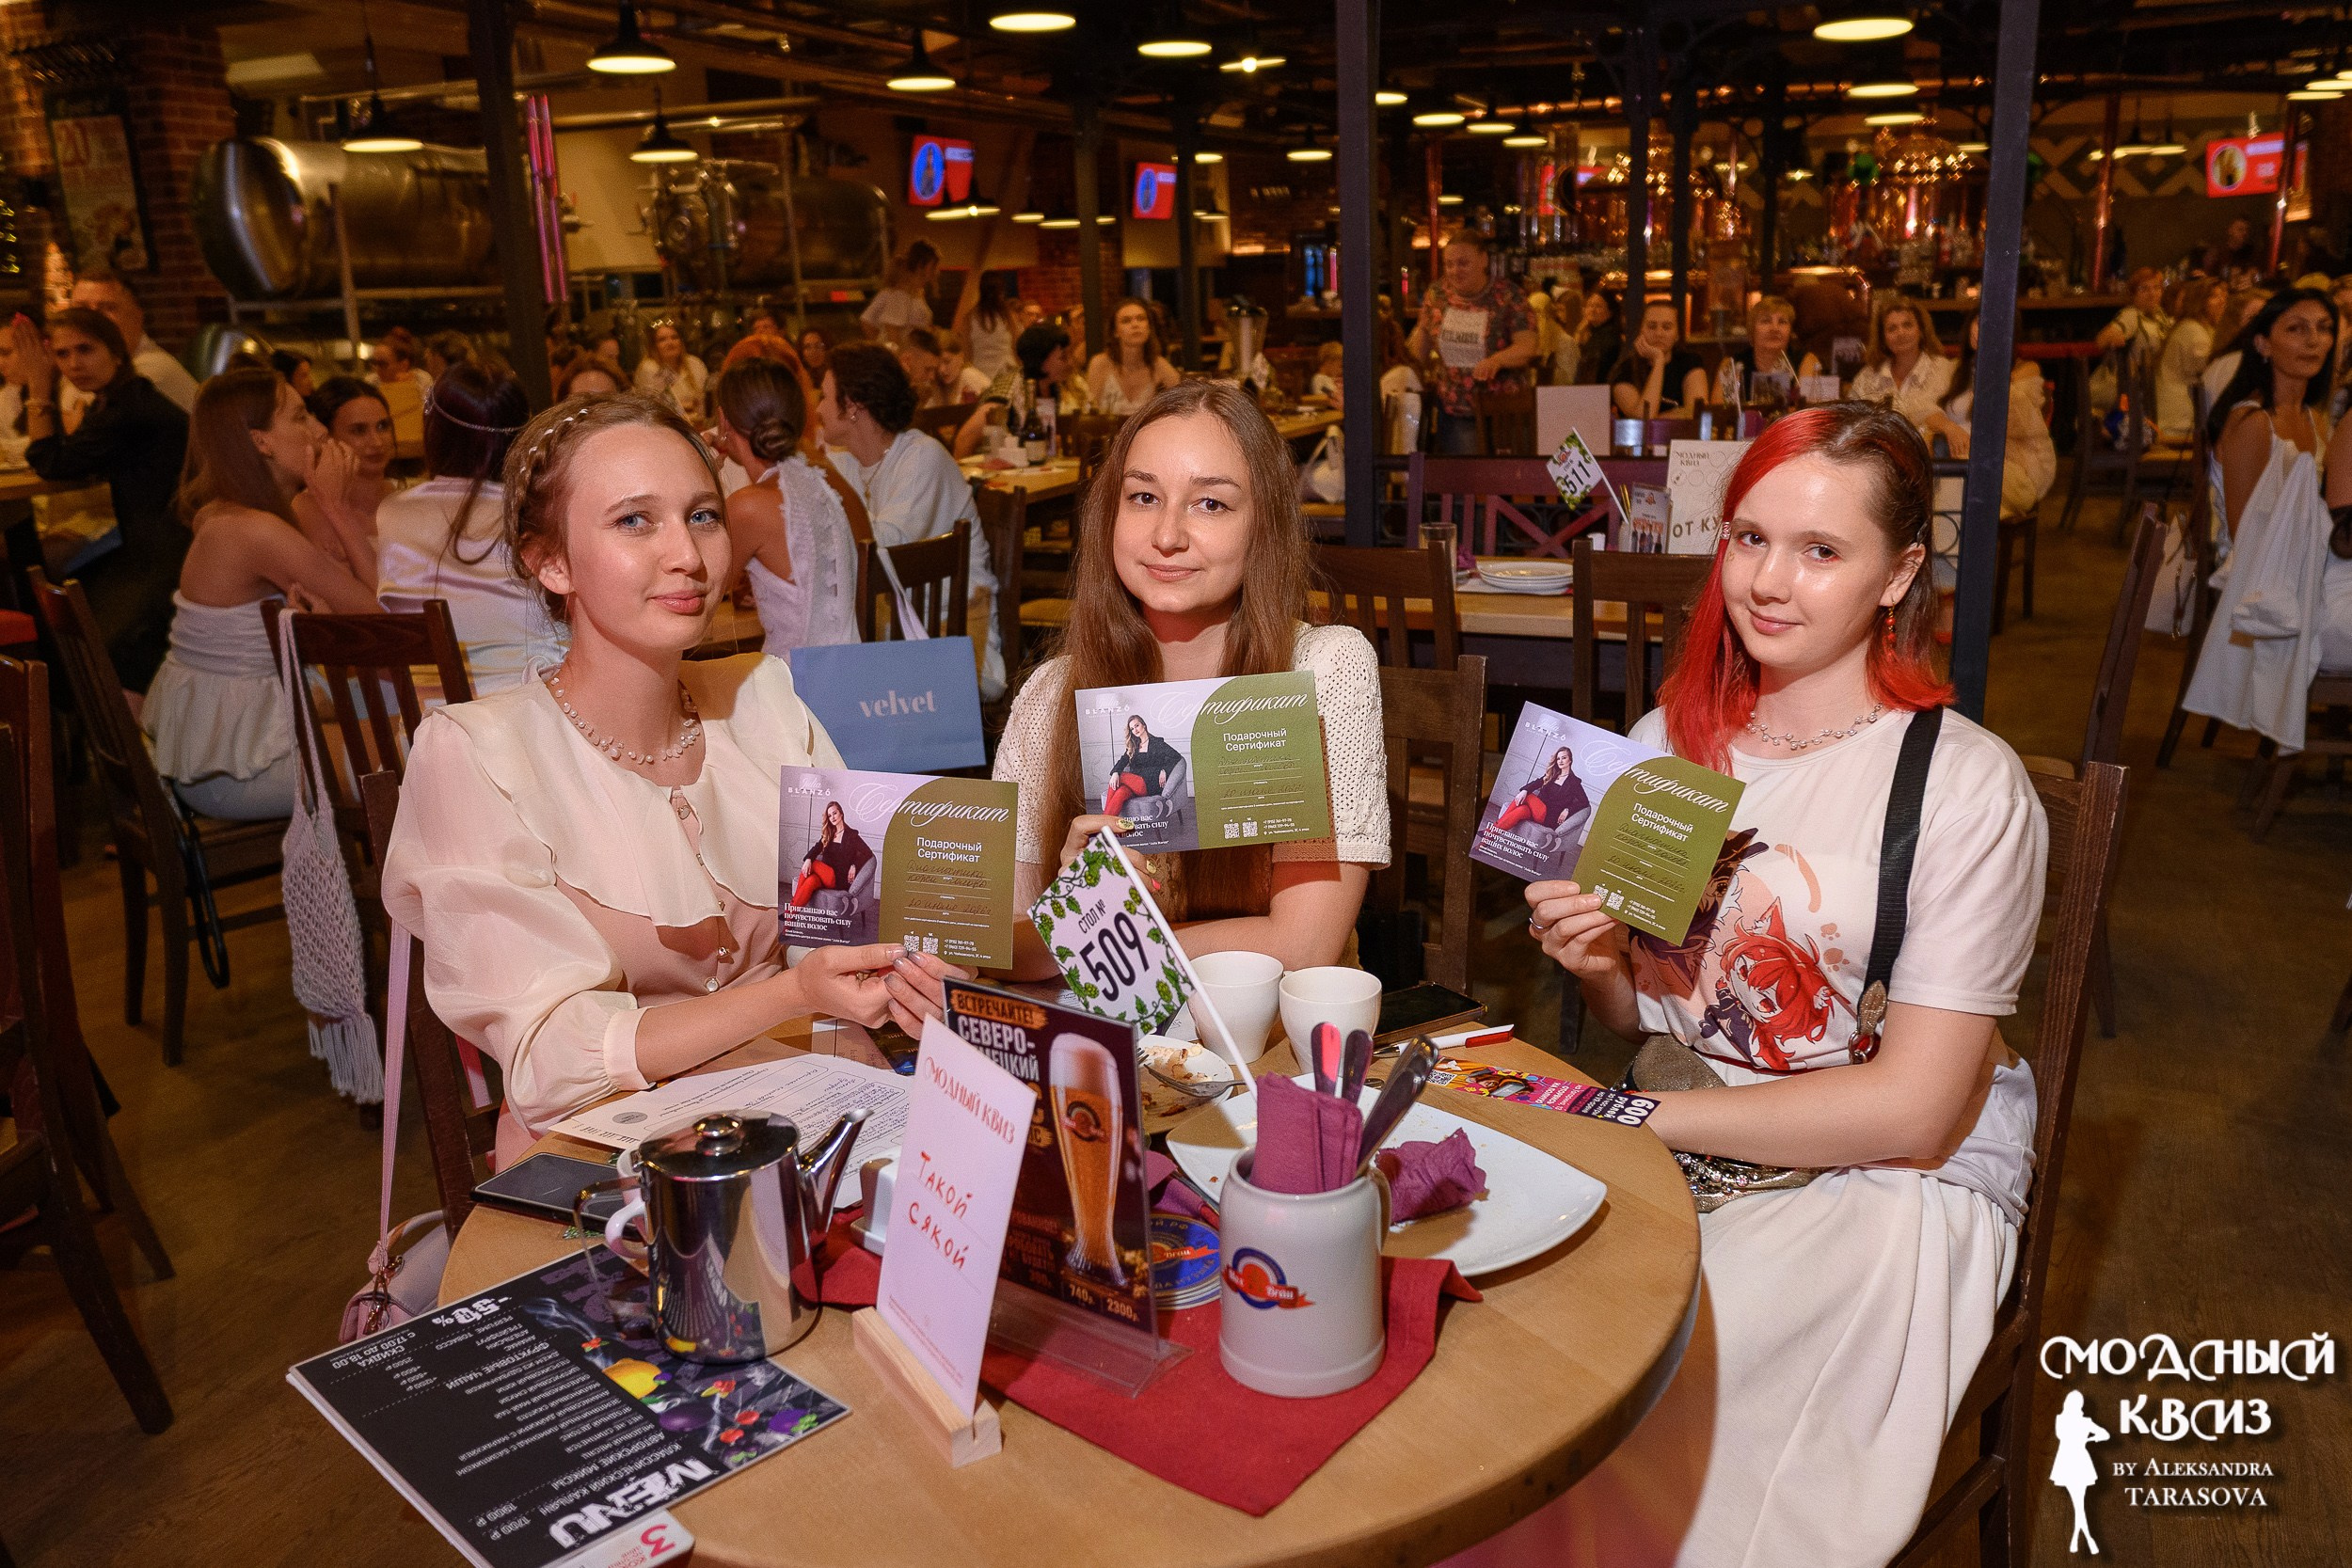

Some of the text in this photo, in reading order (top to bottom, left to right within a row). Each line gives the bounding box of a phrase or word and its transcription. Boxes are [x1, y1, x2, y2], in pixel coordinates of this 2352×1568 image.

[1564, 460, 1592, 496] 511
[1673, 521, 1694, 538] ОТ
[859, 689, 937, 719] velvet
[1223, 728, 1287, 742] Подарочный
[1226, 739, 1286, 752] Сертификат
[849, 783, 1009, 827] Сертификат
[1633, 802, 1693, 832] Подарочный
[1486, 822, 1539, 849] Приглашаю вас
[1631, 813, 1689, 842] Сертификат
[916, 836, 982, 852] Подарочный
[917, 848, 980, 863] Сертификат
[1481, 837, 1502, 850] ваших
[1502, 847, 1524, 859] волос
[1483, 831, 1533, 855] почувствовать
[1533, 850, 1549, 862] силу
[784, 903, 826, 915] Приглашаю
[784, 912, 852, 927] почувствовать силу
[1078, 899, 1106, 934] СТОЛ №
[807, 923, 828, 931] волос
[1079, 911, 1150, 1002] 509
[957, 993, 1035, 1025] ВСТРЕЧАЙТЕ!
[958, 1015, 1036, 1054] СЕВЕРО-
[975, 1045, 1040, 1082] ЕЦКИЙ
[925, 1056, 980, 1117] МОДНЫЙ
[981, 1103, 1015, 1145] КВИЗ
[1604, 1096, 1629, 1118] рублей
[1617, 1099, 1655, 1125] 600
[361, 1345, 380, 1355] до
[378, 1335, 407, 1350] 17.00
[434, 1332, 472, 1350] TOBACCO
[330, 1353, 364, 1369] 18.00
[356, 1344, 405, 1368] СКИДКА
[444, 1341, 550, 1389] ФРУКТОВЫЕ ЧАШИ
[596, 1431, 668, 1467] АВТОРСКИЕ
[550, 1463, 599, 1490] МИКСЫ
[586, 1442, 682, 1492] КЛАССИЧЕСКИЙ
[537, 1486, 591, 1515] КАЛЬЯН
[549, 1458, 715, 1548] MENU
[499, 1515, 532, 1535] 1700
[640, 1524, 677, 1558] 3
